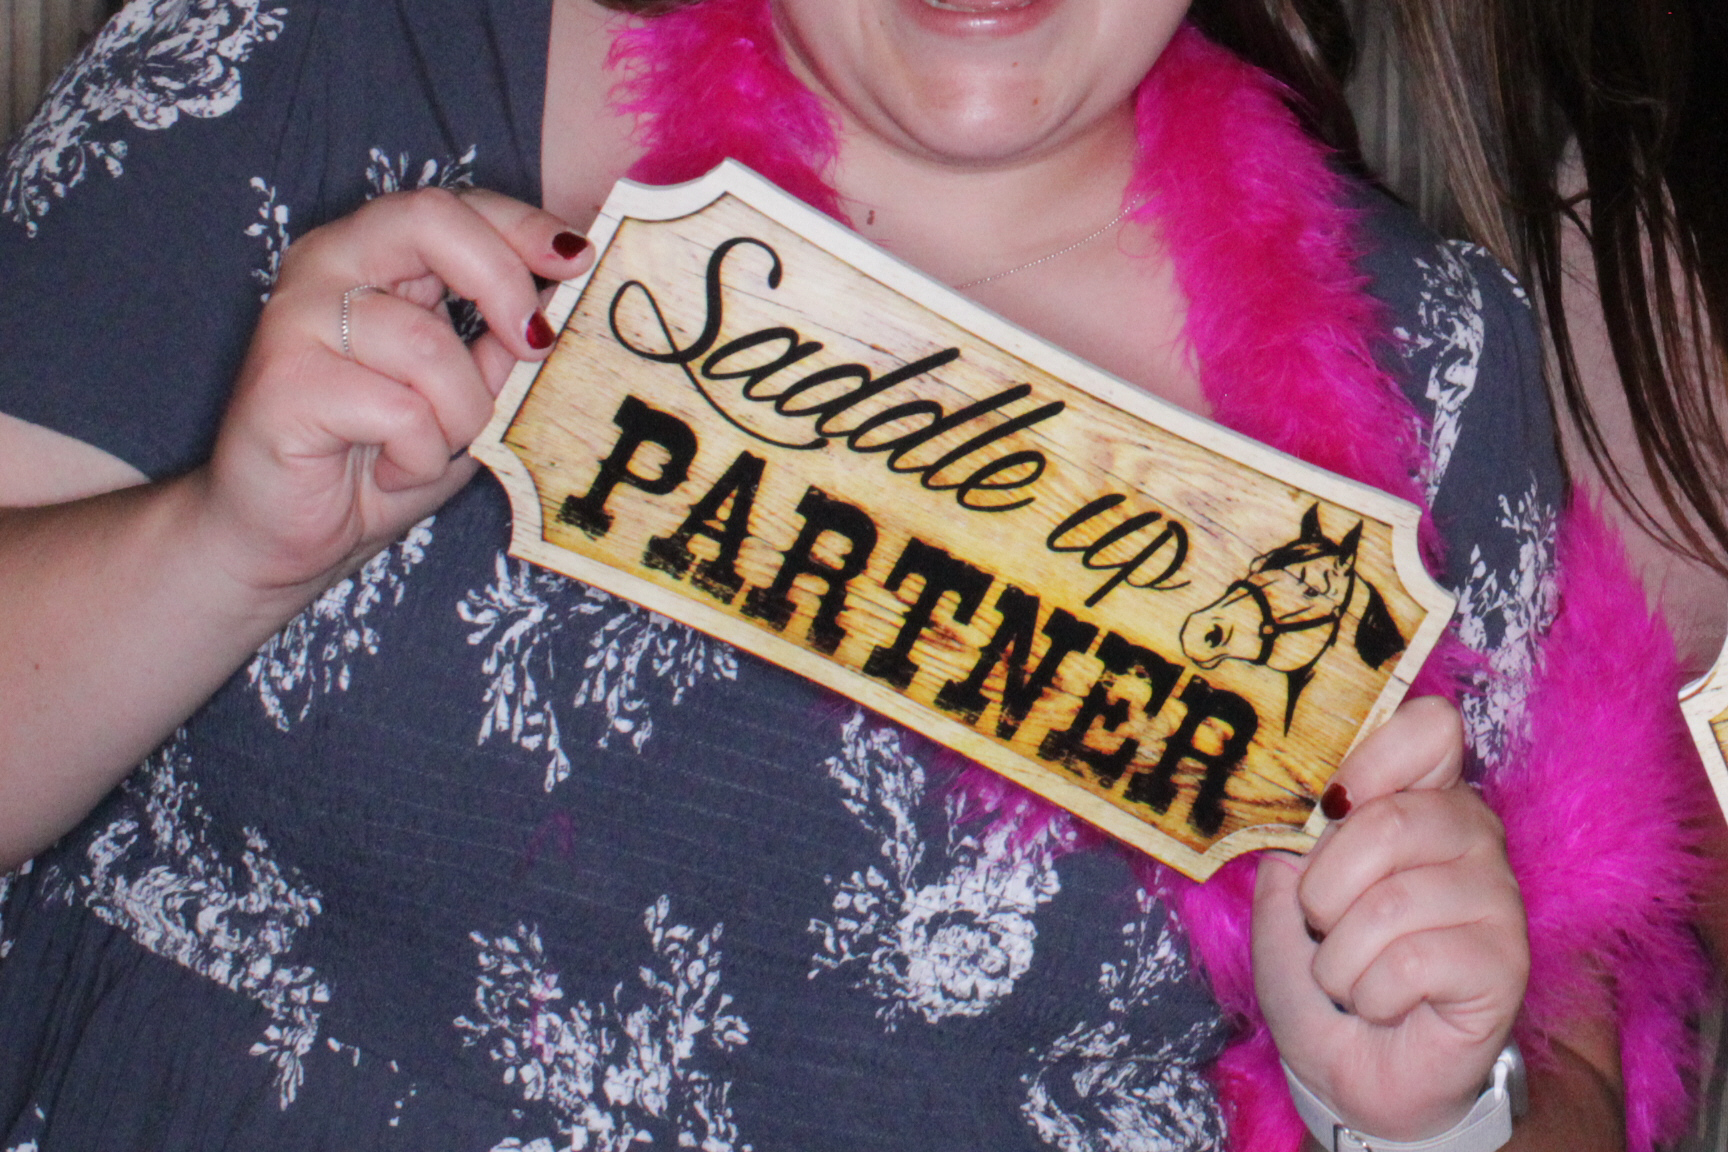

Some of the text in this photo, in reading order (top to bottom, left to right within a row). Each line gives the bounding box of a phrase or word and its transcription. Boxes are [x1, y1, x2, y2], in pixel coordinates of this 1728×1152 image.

[554, 394, 1261, 838] PARTNER
[609, 236, 1192, 607] Saddle up
